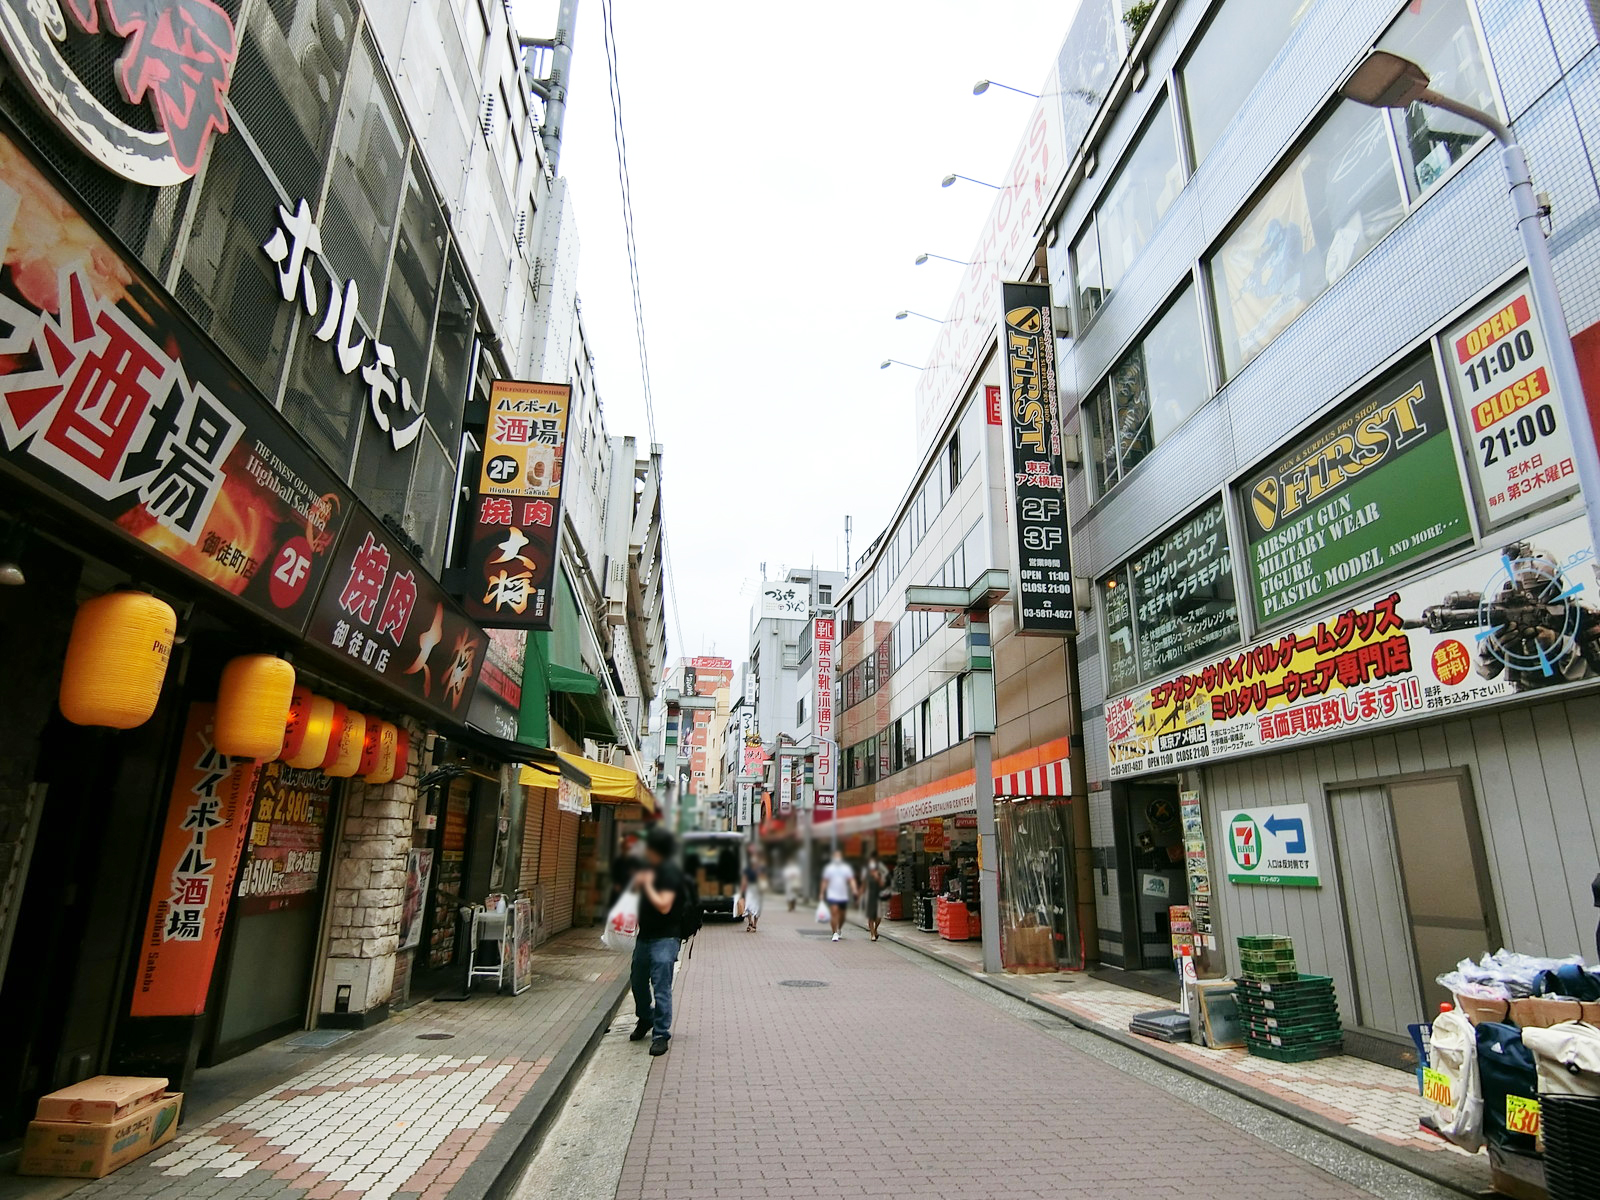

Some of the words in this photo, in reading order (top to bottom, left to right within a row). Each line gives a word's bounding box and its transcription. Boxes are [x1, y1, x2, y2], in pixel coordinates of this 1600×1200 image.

[970, 105, 1048, 296] SHOES
[1466, 304, 1519, 357] OPEN
[1464, 328, 1535, 393] 11:00
[0, 270, 232, 534] 酒場
[496, 398, 562, 414] ハイボール
[1009, 330, 1046, 454] FIRST
[1477, 373, 1542, 429] CLOSE
[496, 416, 559, 445] 酒場
[1278, 460, 1295, 474] GUN
[1295, 453, 1302, 462] &
[1302, 430, 1336, 458] SURPLUS
[1337, 418, 1354, 435] PRO
[1355, 400, 1379, 422] SHOP
[1280, 379, 1427, 520] FIRST
[1479, 403, 1557, 469] 21:00
[254, 439, 270, 462] THE
[269, 453, 297, 482] FINEST
[293, 476, 308, 496] OLD
[489, 459, 518, 480] 2F
[1016, 474, 1063, 488] アメ横店
[1026, 462, 1050, 475] 東京
[1488, 491, 1506, 508] 毎月
[1506, 456, 1575, 501] 第3木曜日
[1506, 453, 1543, 481] 定休日
[245, 454, 296, 506] Highball
[291, 493, 327, 532] Sakaba
[480, 497, 554, 527] 焼肉
[1022, 497, 1061, 522] 2F
[1024, 526, 1062, 551] 3F
[1255, 511, 1315, 563] AIRSOFT
[1316, 493, 1352, 527] GUN
[1257, 530, 1327, 580] MILITARY
[1327, 501, 1381, 542] WEAR
[201, 531, 258, 579] 御徒町店
[274, 546, 311, 588] 2F
[482, 526, 538, 615] 大将
[1021, 570, 1042, 580] OPEN
[1047, 571, 1069, 581] 11:00
[1144, 532, 1217, 595] ミリタリーウェア
[1260, 556, 1314, 598] FIGURE
[1262, 574, 1323, 617] PLASTIC
[1323, 546, 1385, 589] MODEL
[1388, 538, 1411, 558] AND
[338, 530, 418, 647] 焼肉
[1022, 582, 1047, 593] CLOSE
[1047, 583, 1071, 594] 21:00
[330, 619, 392, 674] 御徒町店
[817, 621, 833, 638] 靴
[1150, 592, 1405, 710] エアガン・サバイバルゲームグッズ
[402, 601, 481, 711] 大将
[1434, 643, 1462, 665] 査定
[1436, 657, 1469, 683] 無料!
[1210, 635, 1412, 722] ミリタリーウェア専門店
[1424, 685, 1442, 698] 是非
[1426, 683, 1506, 709] お持ち込み下さい!!
[817, 640, 831, 786] 東京靴流通センター
[1111, 701, 1126, 721] 日本
[1257, 676, 1422, 742] 高価買取致します!!
[1117, 735, 1155, 762] FIRST
[1147, 755, 1160, 768] OPEN
[1160, 753, 1174, 765] 11:00
[1176, 750, 1193, 763] CLOSE
[1193, 745, 1210, 759] 21:00
[1159, 726, 1207, 751] 東京アメ横店
[252, 763, 280, 847] 食べ放題
[915, 800, 933, 816] SHOES
[166, 746, 223, 939] ハイボール酒場
[286, 850, 322, 873] 飲み放題
[1267, 859, 1310, 869] 入口は反対側です
[150, 900, 168, 946] Highball
[142, 951, 159, 993] Sakaba
